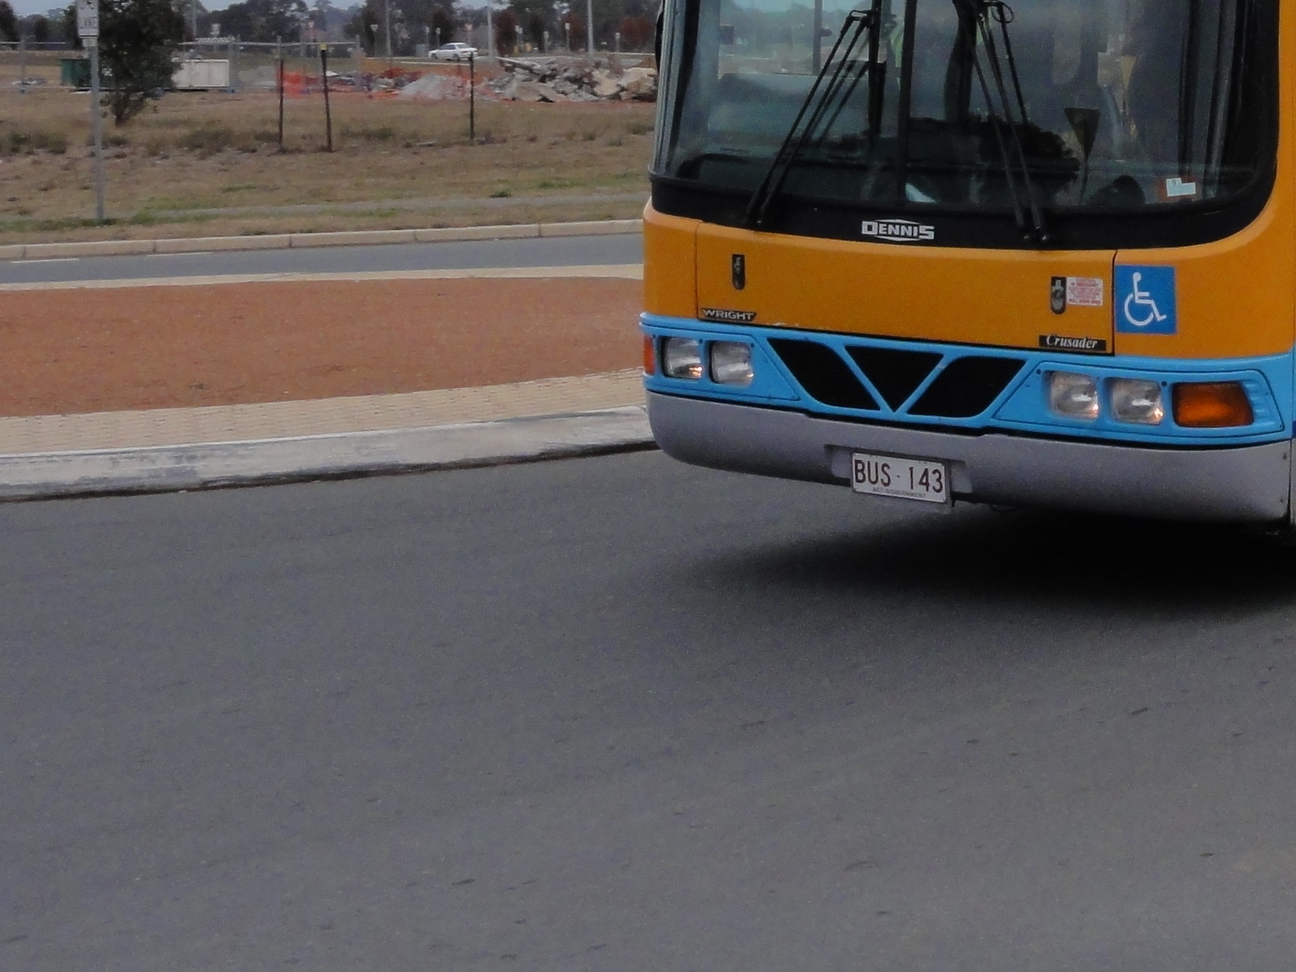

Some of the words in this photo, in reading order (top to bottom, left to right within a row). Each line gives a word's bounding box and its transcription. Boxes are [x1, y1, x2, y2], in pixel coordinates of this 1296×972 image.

[861, 218, 935, 241] DENNIS
[702, 308, 755, 321] WRIGHT
[1046, 334, 1098, 349] Crusader
[854, 459, 891, 488] BUS
[908, 466, 944, 494] 143
